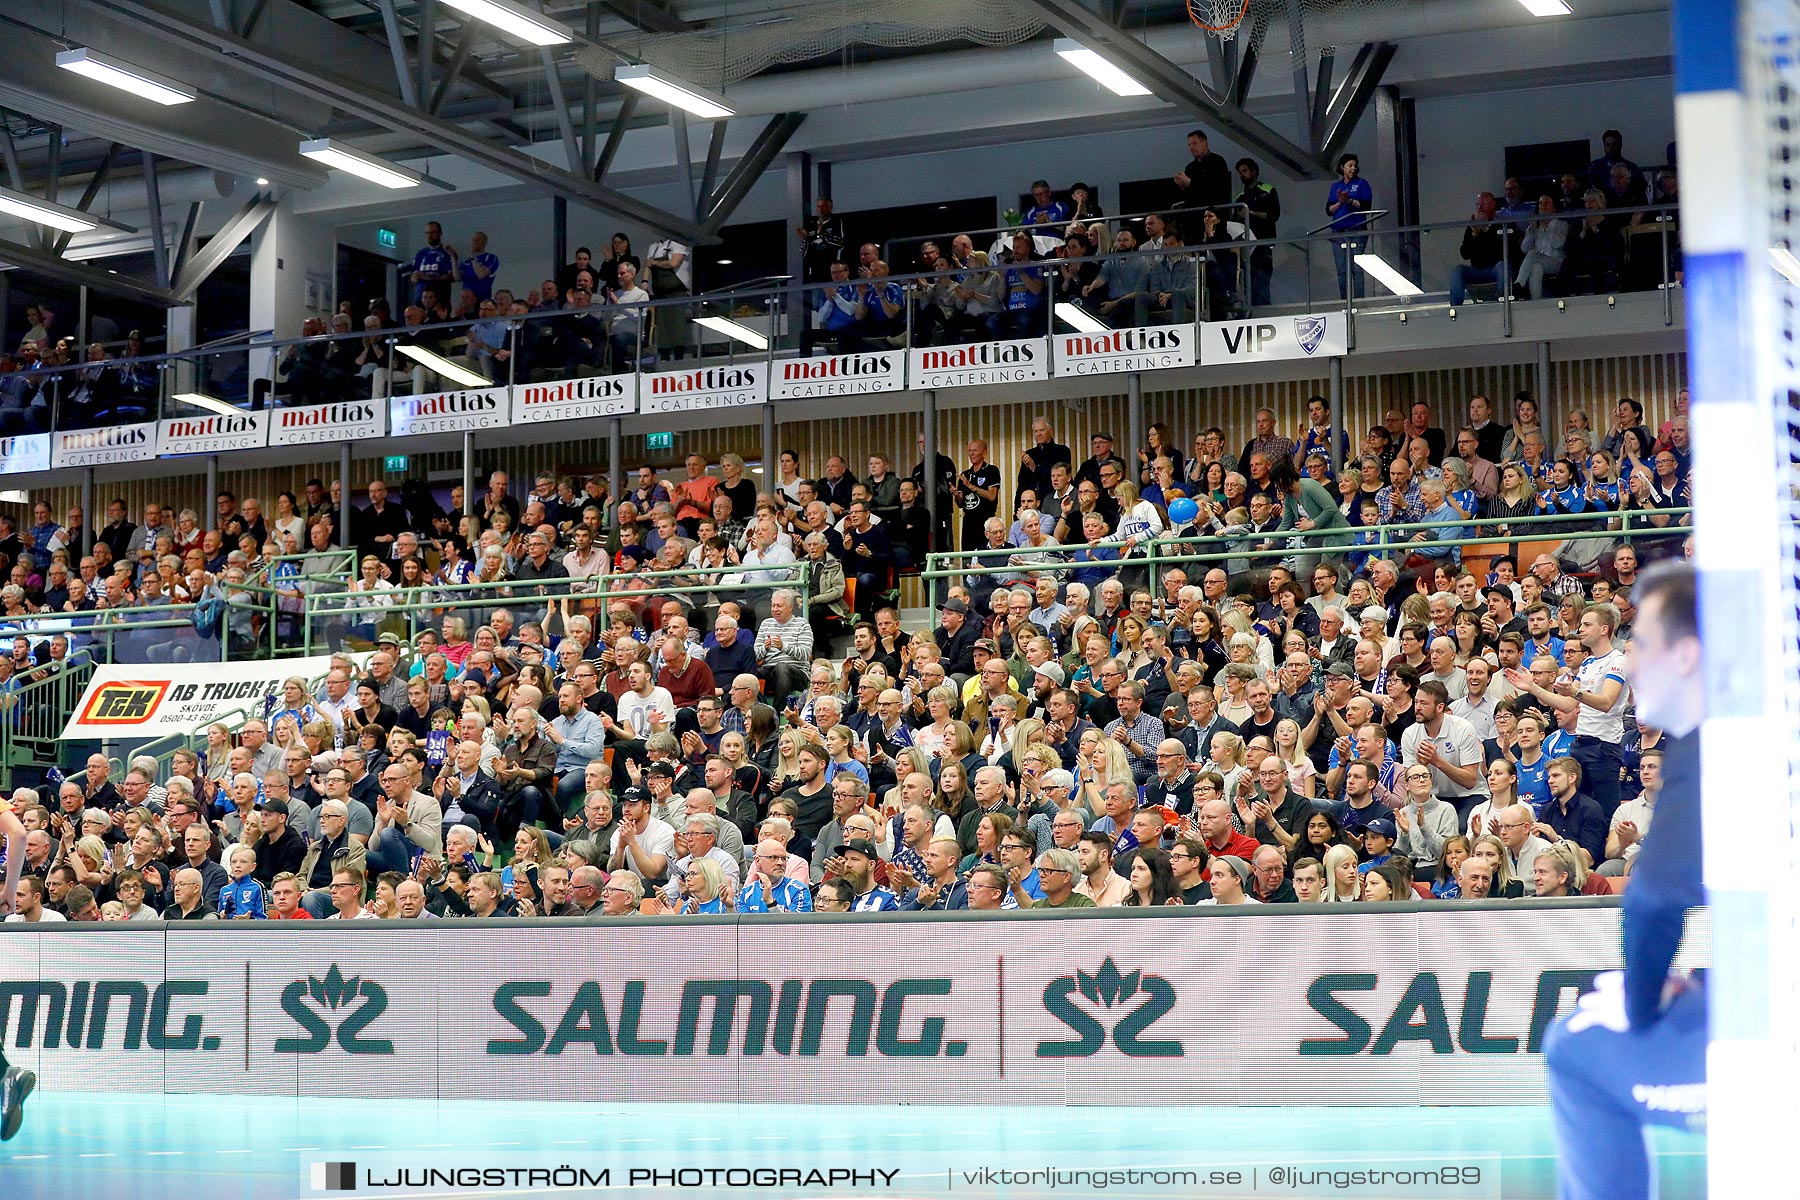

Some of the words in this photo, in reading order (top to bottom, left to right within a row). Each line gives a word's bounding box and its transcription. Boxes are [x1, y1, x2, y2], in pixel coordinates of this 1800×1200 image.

[1067, 327, 1180, 356] mattias
[1221, 324, 1277, 355] VIP
[922, 341, 1033, 369] mattias
[1076, 356, 1172, 374] CATERING
[784, 353, 891, 380] mattias
[652, 366, 755, 394] mattias
[932, 369, 1025, 386] CATERING
[524, 377, 623, 404] mattias
[792, 380, 882, 397] CATERING
[401, 392, 496, 417] mattias
[532, 403, 615, 420] CATERING
[661, 393, 747, 411] CATERING
[282, 403, 374, 428] mattias
[409, 417, 489, 433] CATERING
[169, 415, 257, 438] mattias
[287, 428, 366, 443] CATERING
[62, 427, 146, 450] mattias
[174, 437, 249, 453] CATERING
[68, 451, 139, 465] CATERING
[1124, 522, 1143, 536] NYC
[168, 684, 198, 701] AB
[201, 681, 264, 700] TRUCK
[96, 690, 157, 717] T&K
[180, 703, 217, 713] SKÖVDE
[160, 714, 197, 723] 0500-43
[486, 979, 968, 1057] SALMING.
